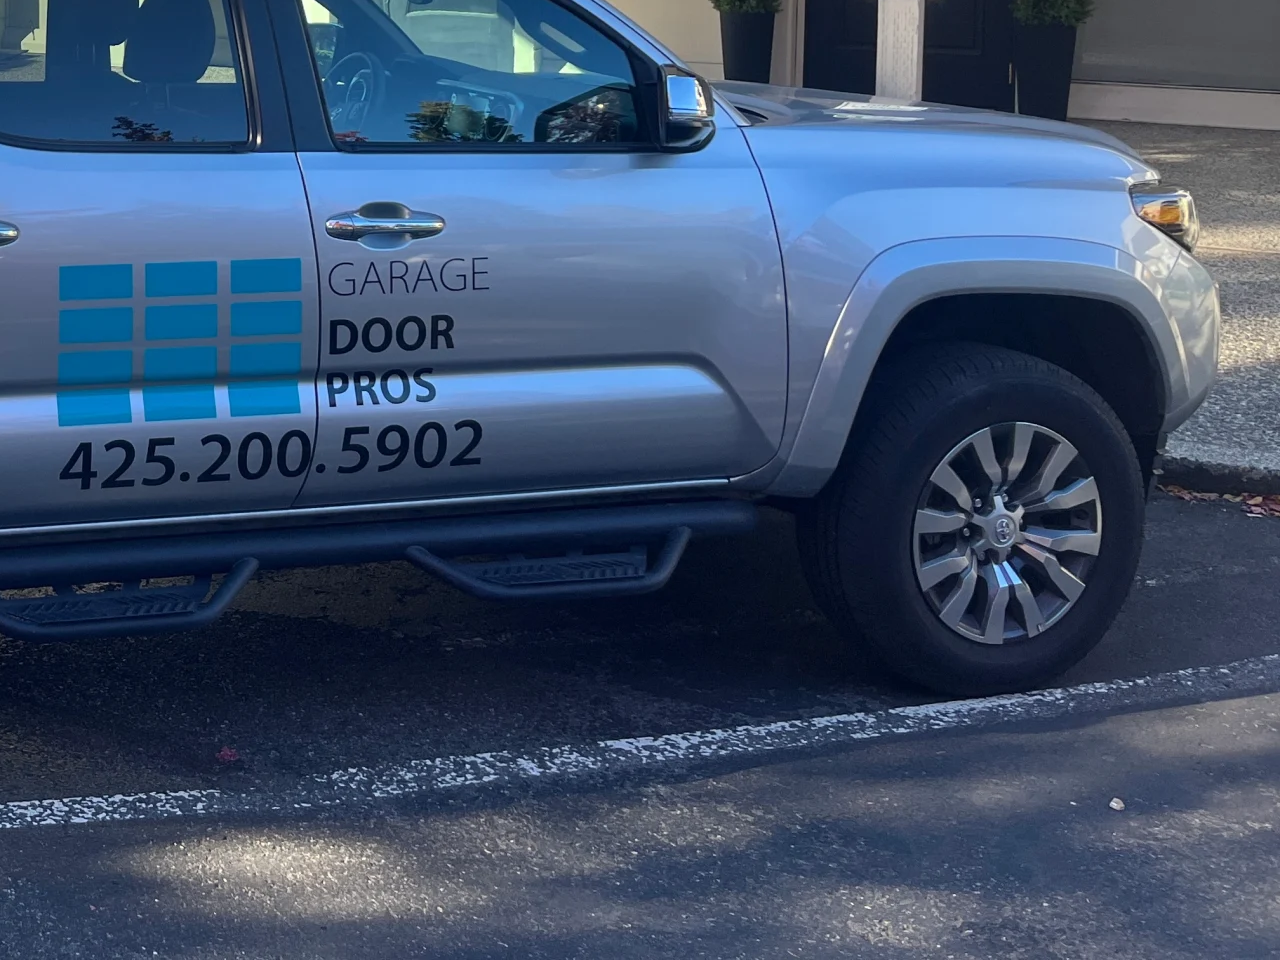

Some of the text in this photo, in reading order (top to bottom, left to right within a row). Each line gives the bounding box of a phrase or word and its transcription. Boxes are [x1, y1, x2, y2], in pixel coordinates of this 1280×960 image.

[327, 256, 491, 297] GARAGE
[328, 314, 456, 356] DOOR
[326, 367, 438, 408] PROS
[58, 419, 484, 491] 425.200.5902
